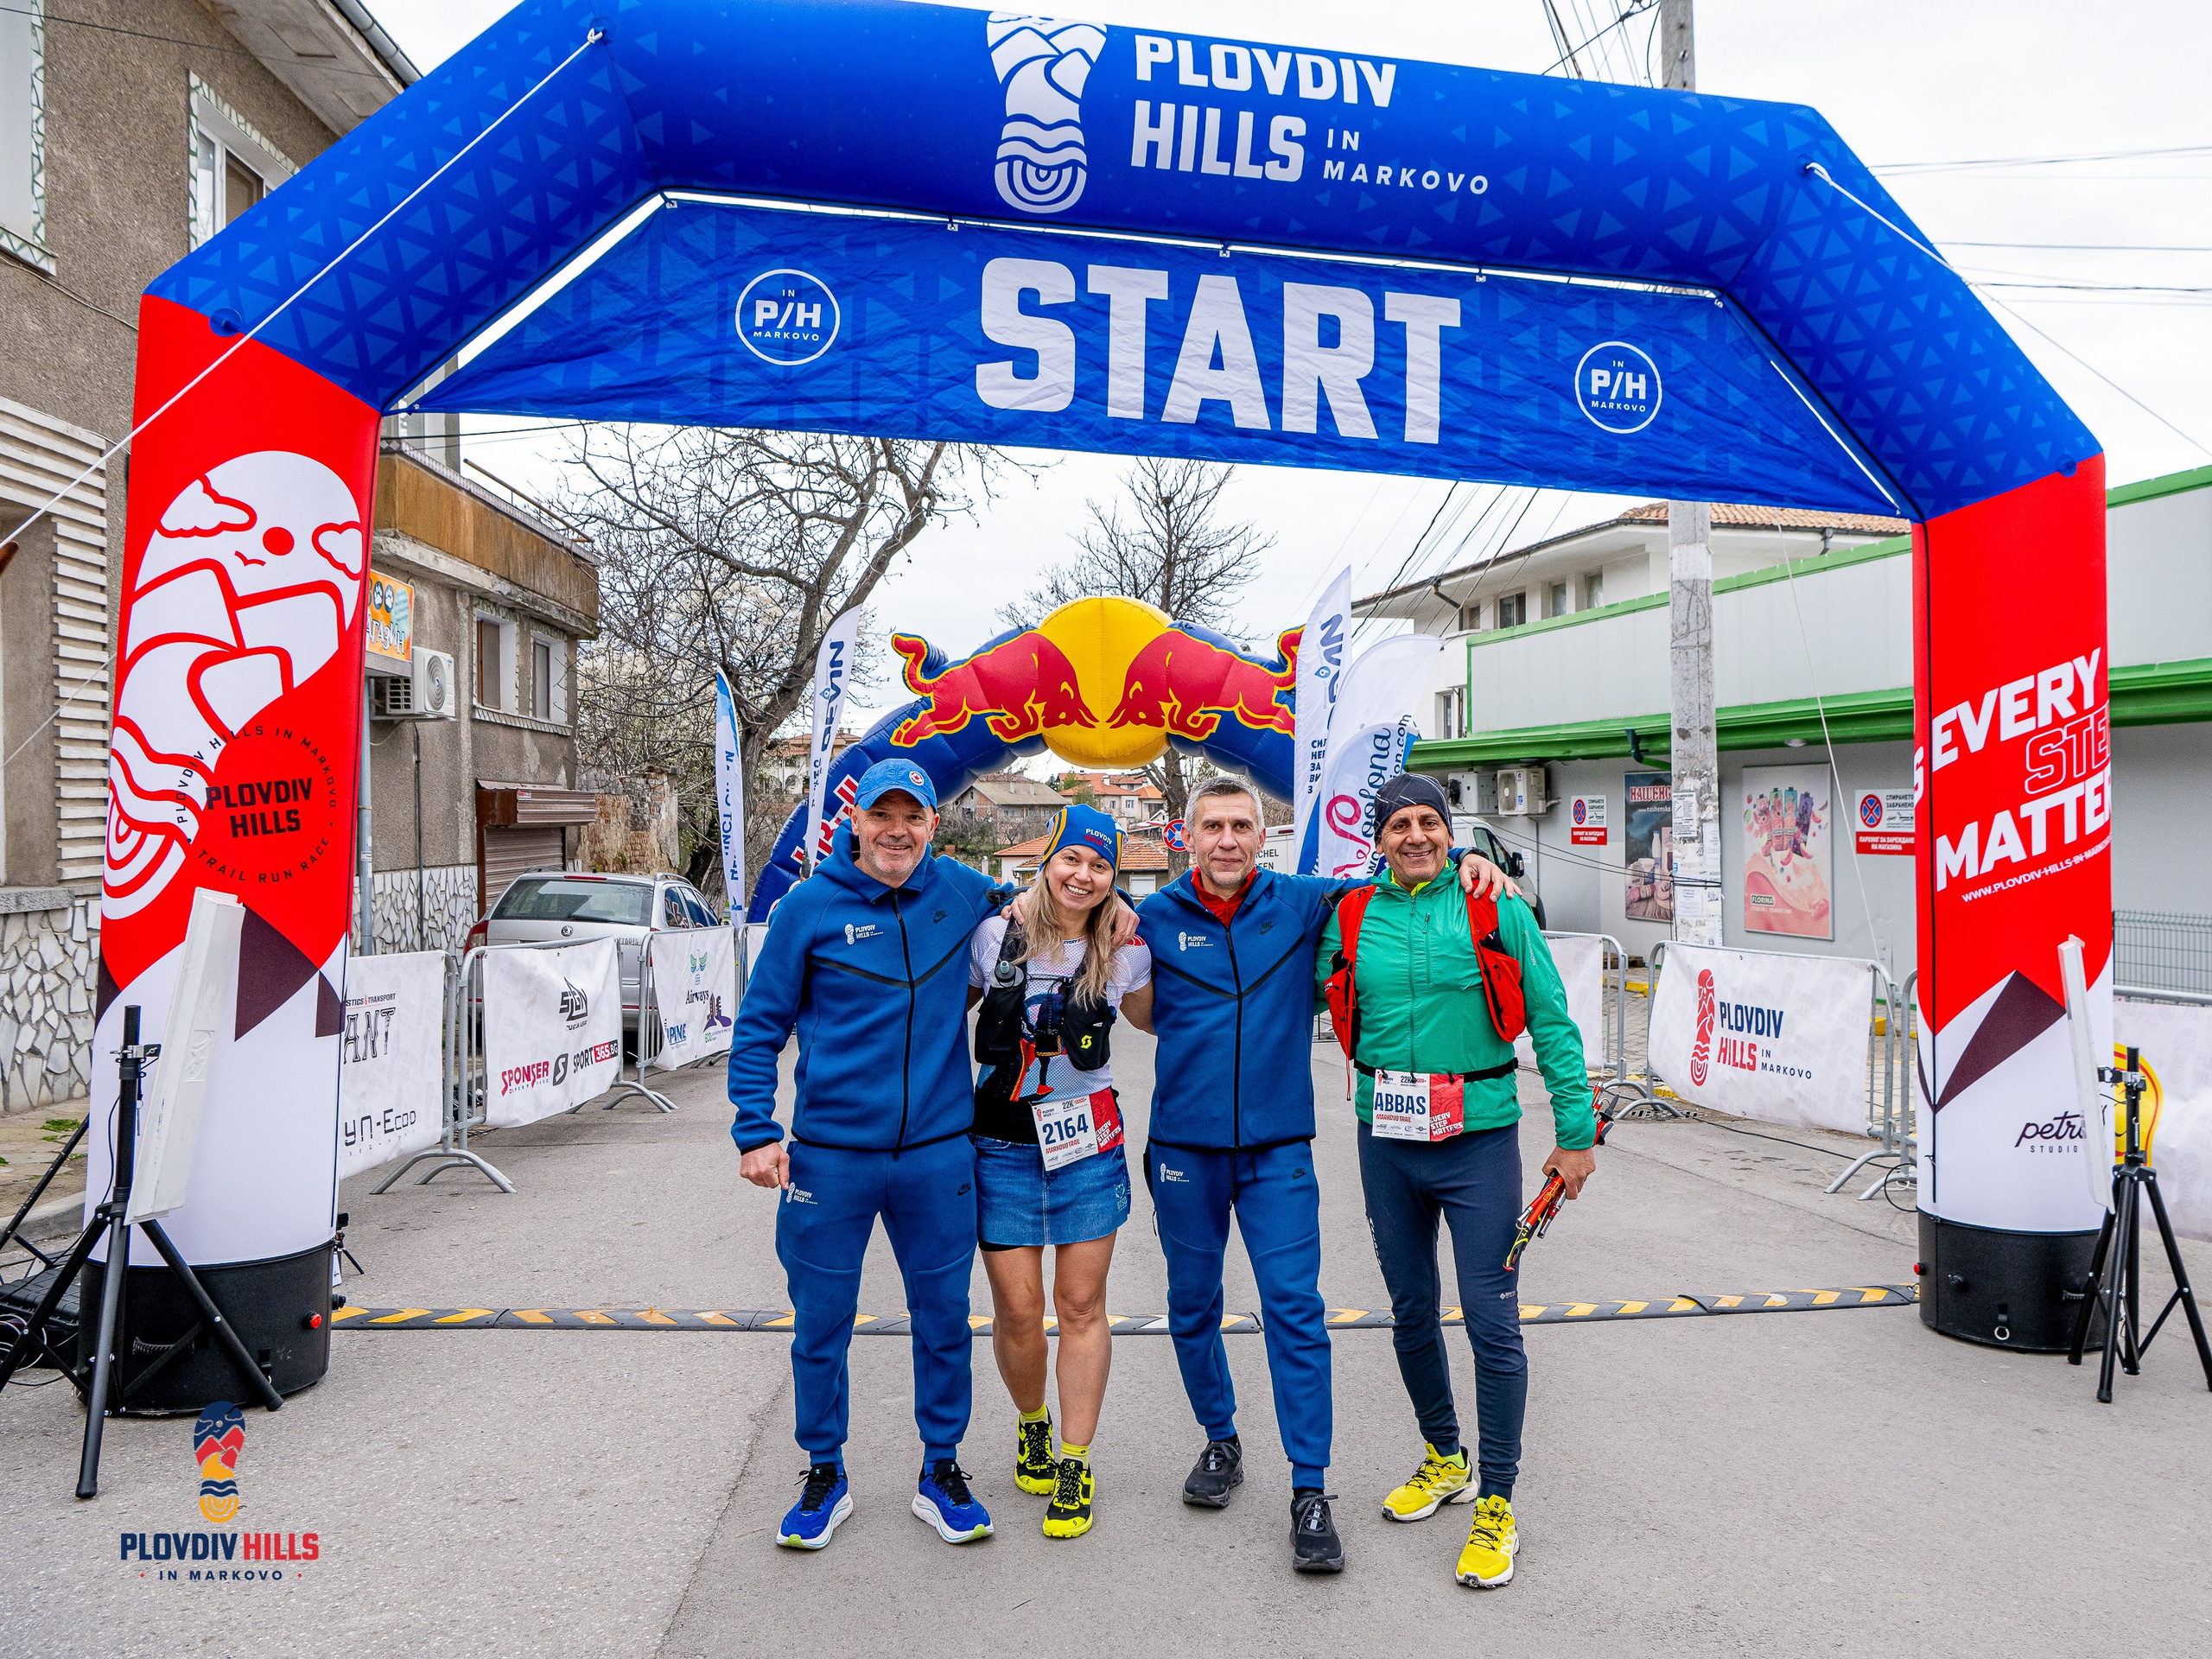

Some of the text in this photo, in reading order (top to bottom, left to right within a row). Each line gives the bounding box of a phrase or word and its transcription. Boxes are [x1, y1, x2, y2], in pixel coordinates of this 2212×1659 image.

[1134, 35, 1397, 108] PLOVDIV
[1129, 99, 1306, 182] HILLS
[1327, 129, 1360, 151] IN
[1324, 161, 1489, 194] MARKOVO
[754, 300, 821, 328] P/H
[753, 331, 819, 341] MARKOVO
[975, 256, 1460, 445] START
[1612, 359, 1624, 368] IN
[1591, 368, 1646, 400] P/H
[1592, 400, 1646, 412] MARKOVO
[821, 640, 844, 752] DEVIN
[1932, 646, 2101, 772] EVERY
[177, 725, 337, 824] PLOVDIV HILLS IN MARKOVO
[205, 778, 312, 810] PLOVDIV
[230, 809, 302, 838] HILLS
[197, 836, 329, 883] TRAIL RUN RACE
[1255, 849, 1279, 858] CHEL
[367, 993, 396, 1005] TRANSPORT
[685, 989, 709, 1004] Airways
[1719, 1001, 1783, 1039] PLOVDIV
[1717, 1037, 1758, 1071] HILLS
[1761, 1048, 1771, 1058] IN
[501, 1061, 550, 1096] SPONSER
[1761, 1062, 1813, 1079] MARKOVO
[1374, 1092, 1426, 1115] ABBAS
[1430, 1111, 1451, 1123] EVERY
[1042, 1113, 1089, 1145] 2164
[1430, 1120, 1448, 1130] STEP
[1046, 1141, 1069, 1154] MARKOVO
[2030, 1145, 2078, 1154] STUDIO
